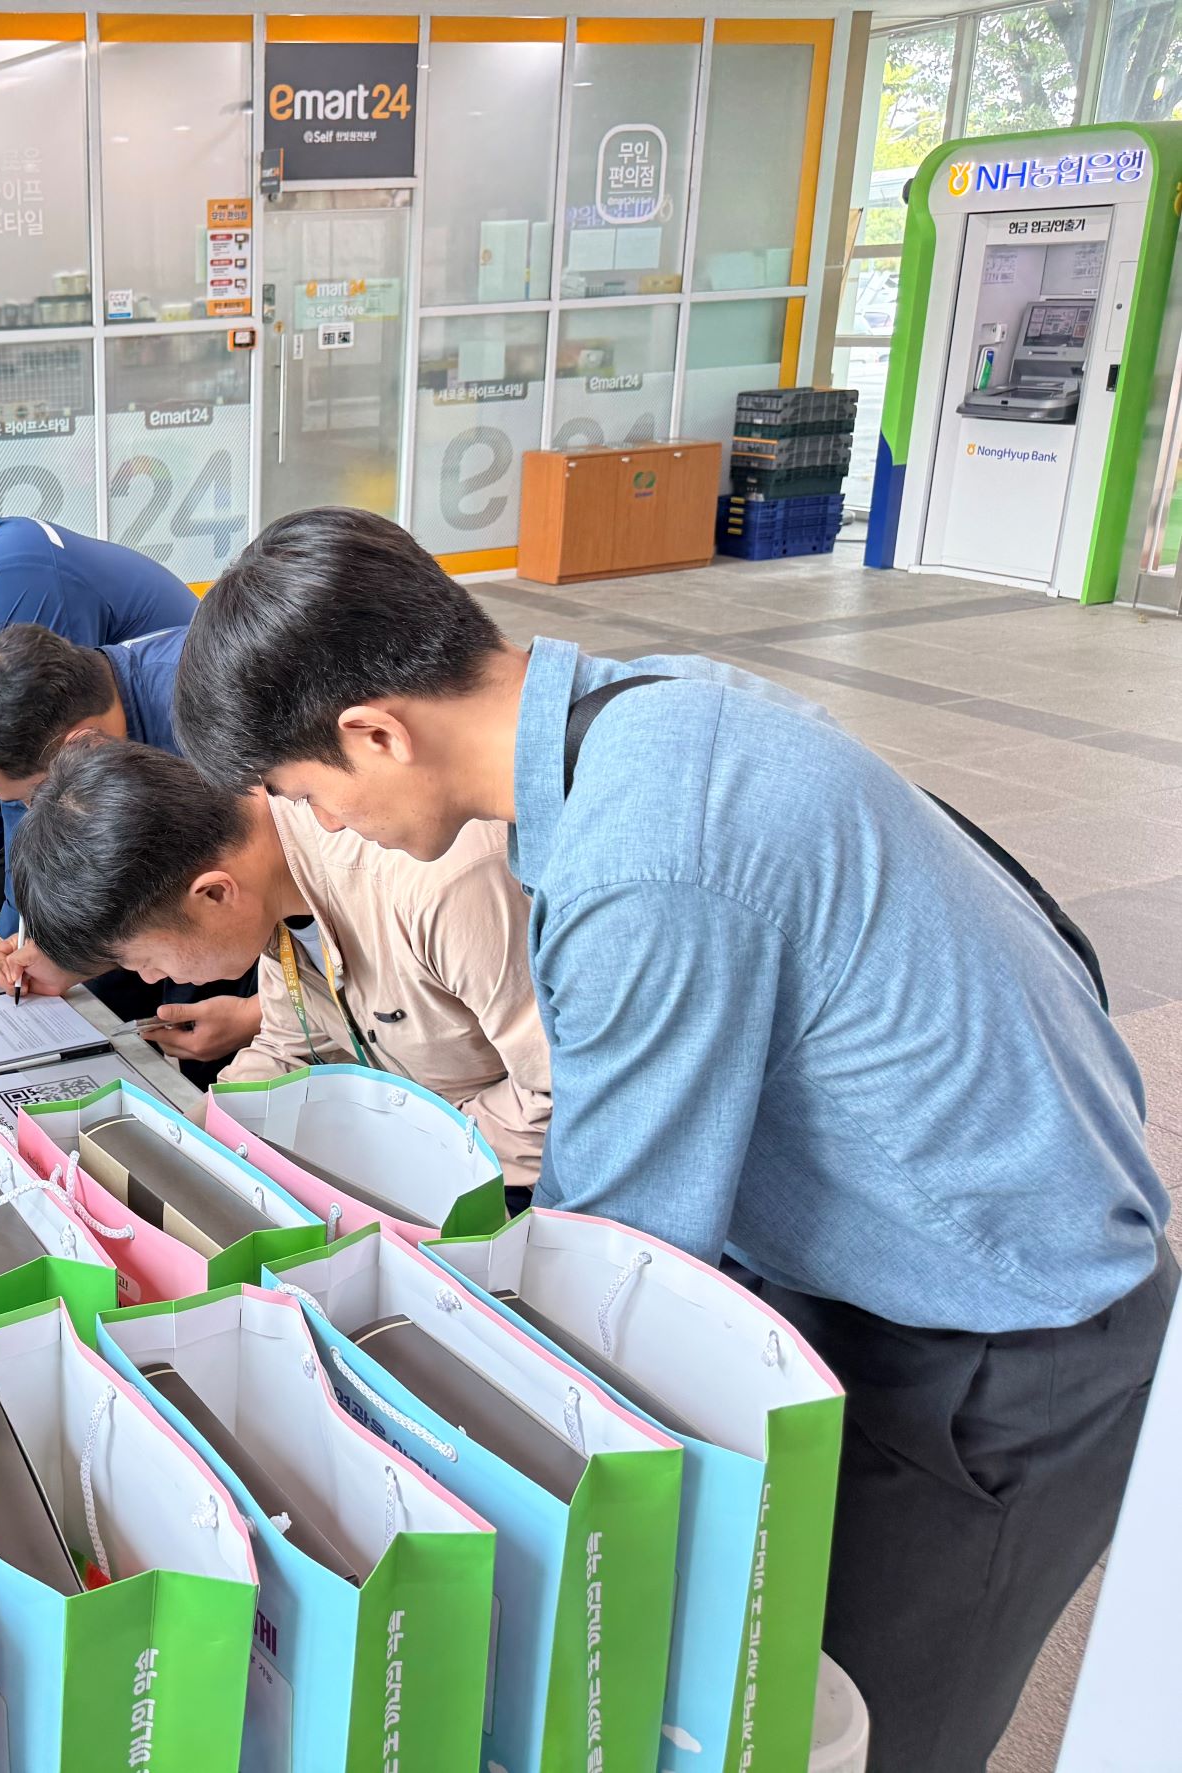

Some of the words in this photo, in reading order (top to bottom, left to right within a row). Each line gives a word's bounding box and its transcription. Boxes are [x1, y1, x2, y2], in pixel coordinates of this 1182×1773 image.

[270, 83, 411, 121] emart24
[618, 141, 649, 165] 무인
[608, 165, 655, 188] 편의점
[975, 150, 1146, 193] NH농협은행
[1009, 221, 1027, 234] 현금
[1031, 218, 1086, 233] 입금/인출기
[338, 304, 364, 316] Store
[438, 388, 465, 401] 새로운
[468, 382, 524, 399] 라이프스타일
[590, 374, 640, 391] emart24
[5, 417, 70, 436] 라이프스타일
[150, 408, 209, 426] emart24
[977, 445, 1030, 462] NongHyup
[1031, 450, 1058, 463] Bank
[586, 1532, 603, 1581] 약속
[586, 1581, 602, 1652] 하나의
[386, 1610, 405, 1661] 약속
[133, 1647, 159, 1695] 약속
[384, 1660, 403, 1732] 하나의
[129, 1698, 156, 1767] 하나의
